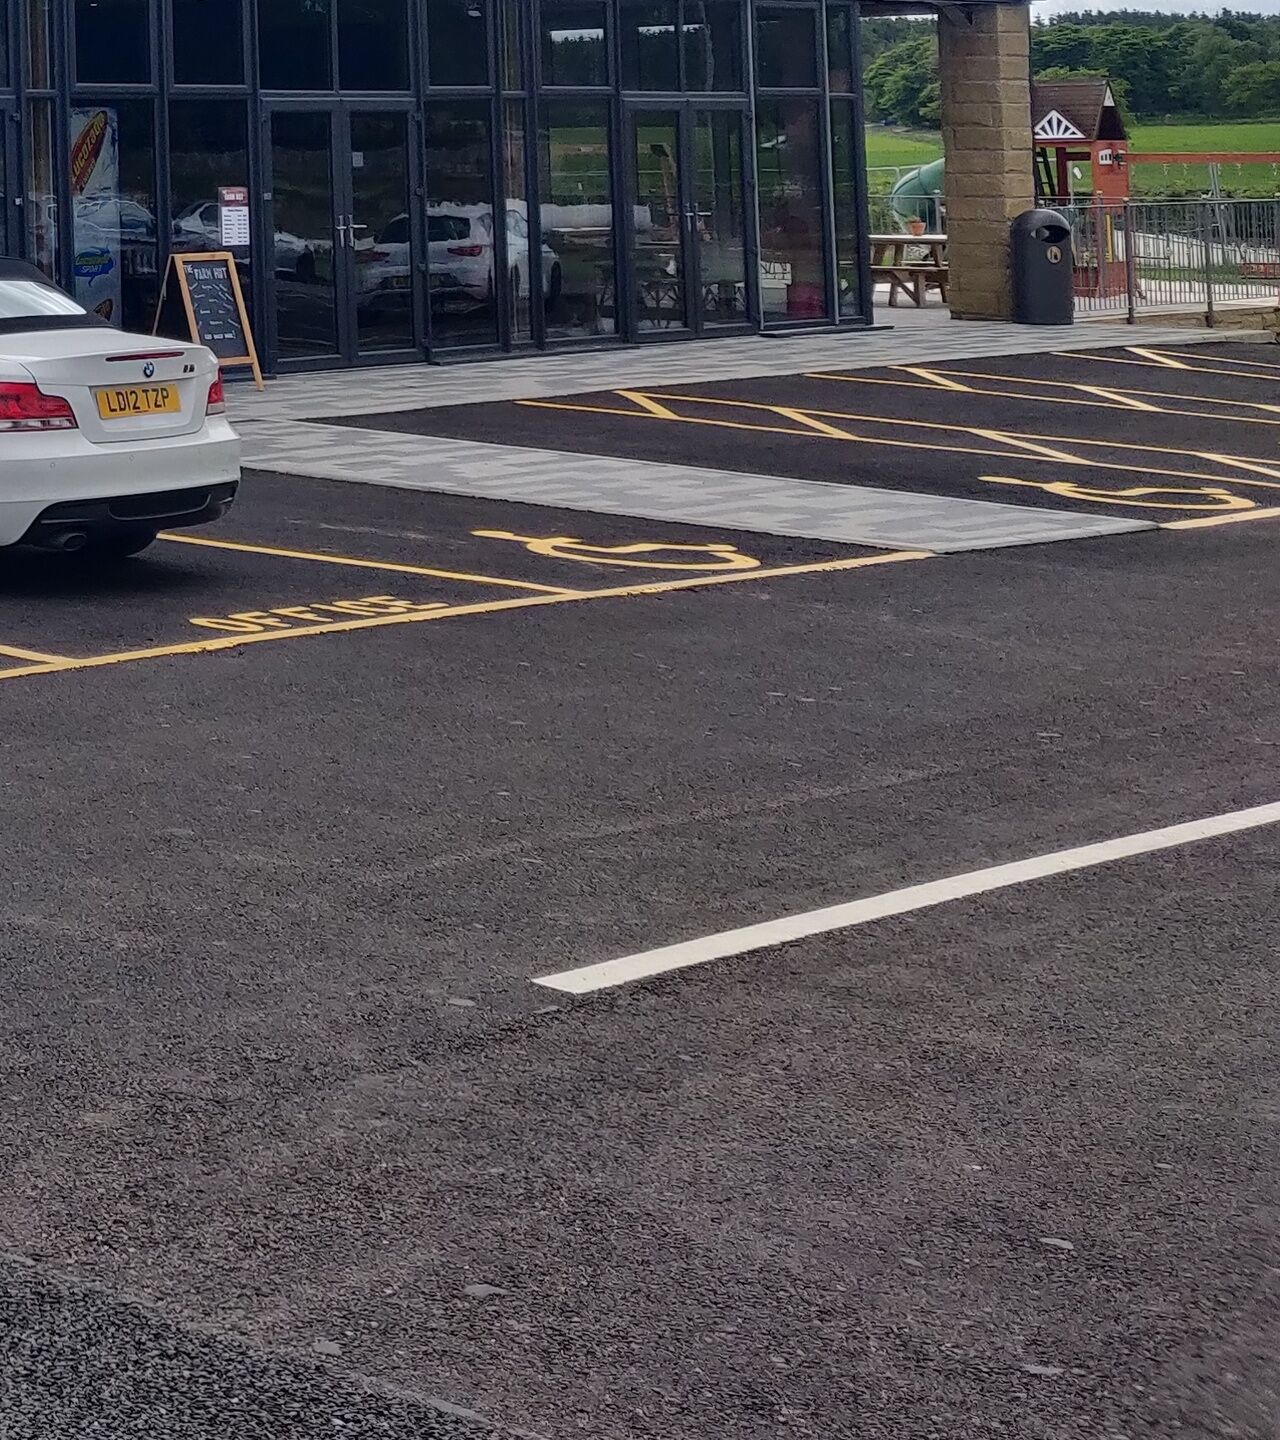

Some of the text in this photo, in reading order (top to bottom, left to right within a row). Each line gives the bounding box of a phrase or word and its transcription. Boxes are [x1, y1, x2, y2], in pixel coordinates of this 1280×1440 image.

[106, 387, 169, 413] LD12 TZP
[187, 595, 450, 633] OFFICE
